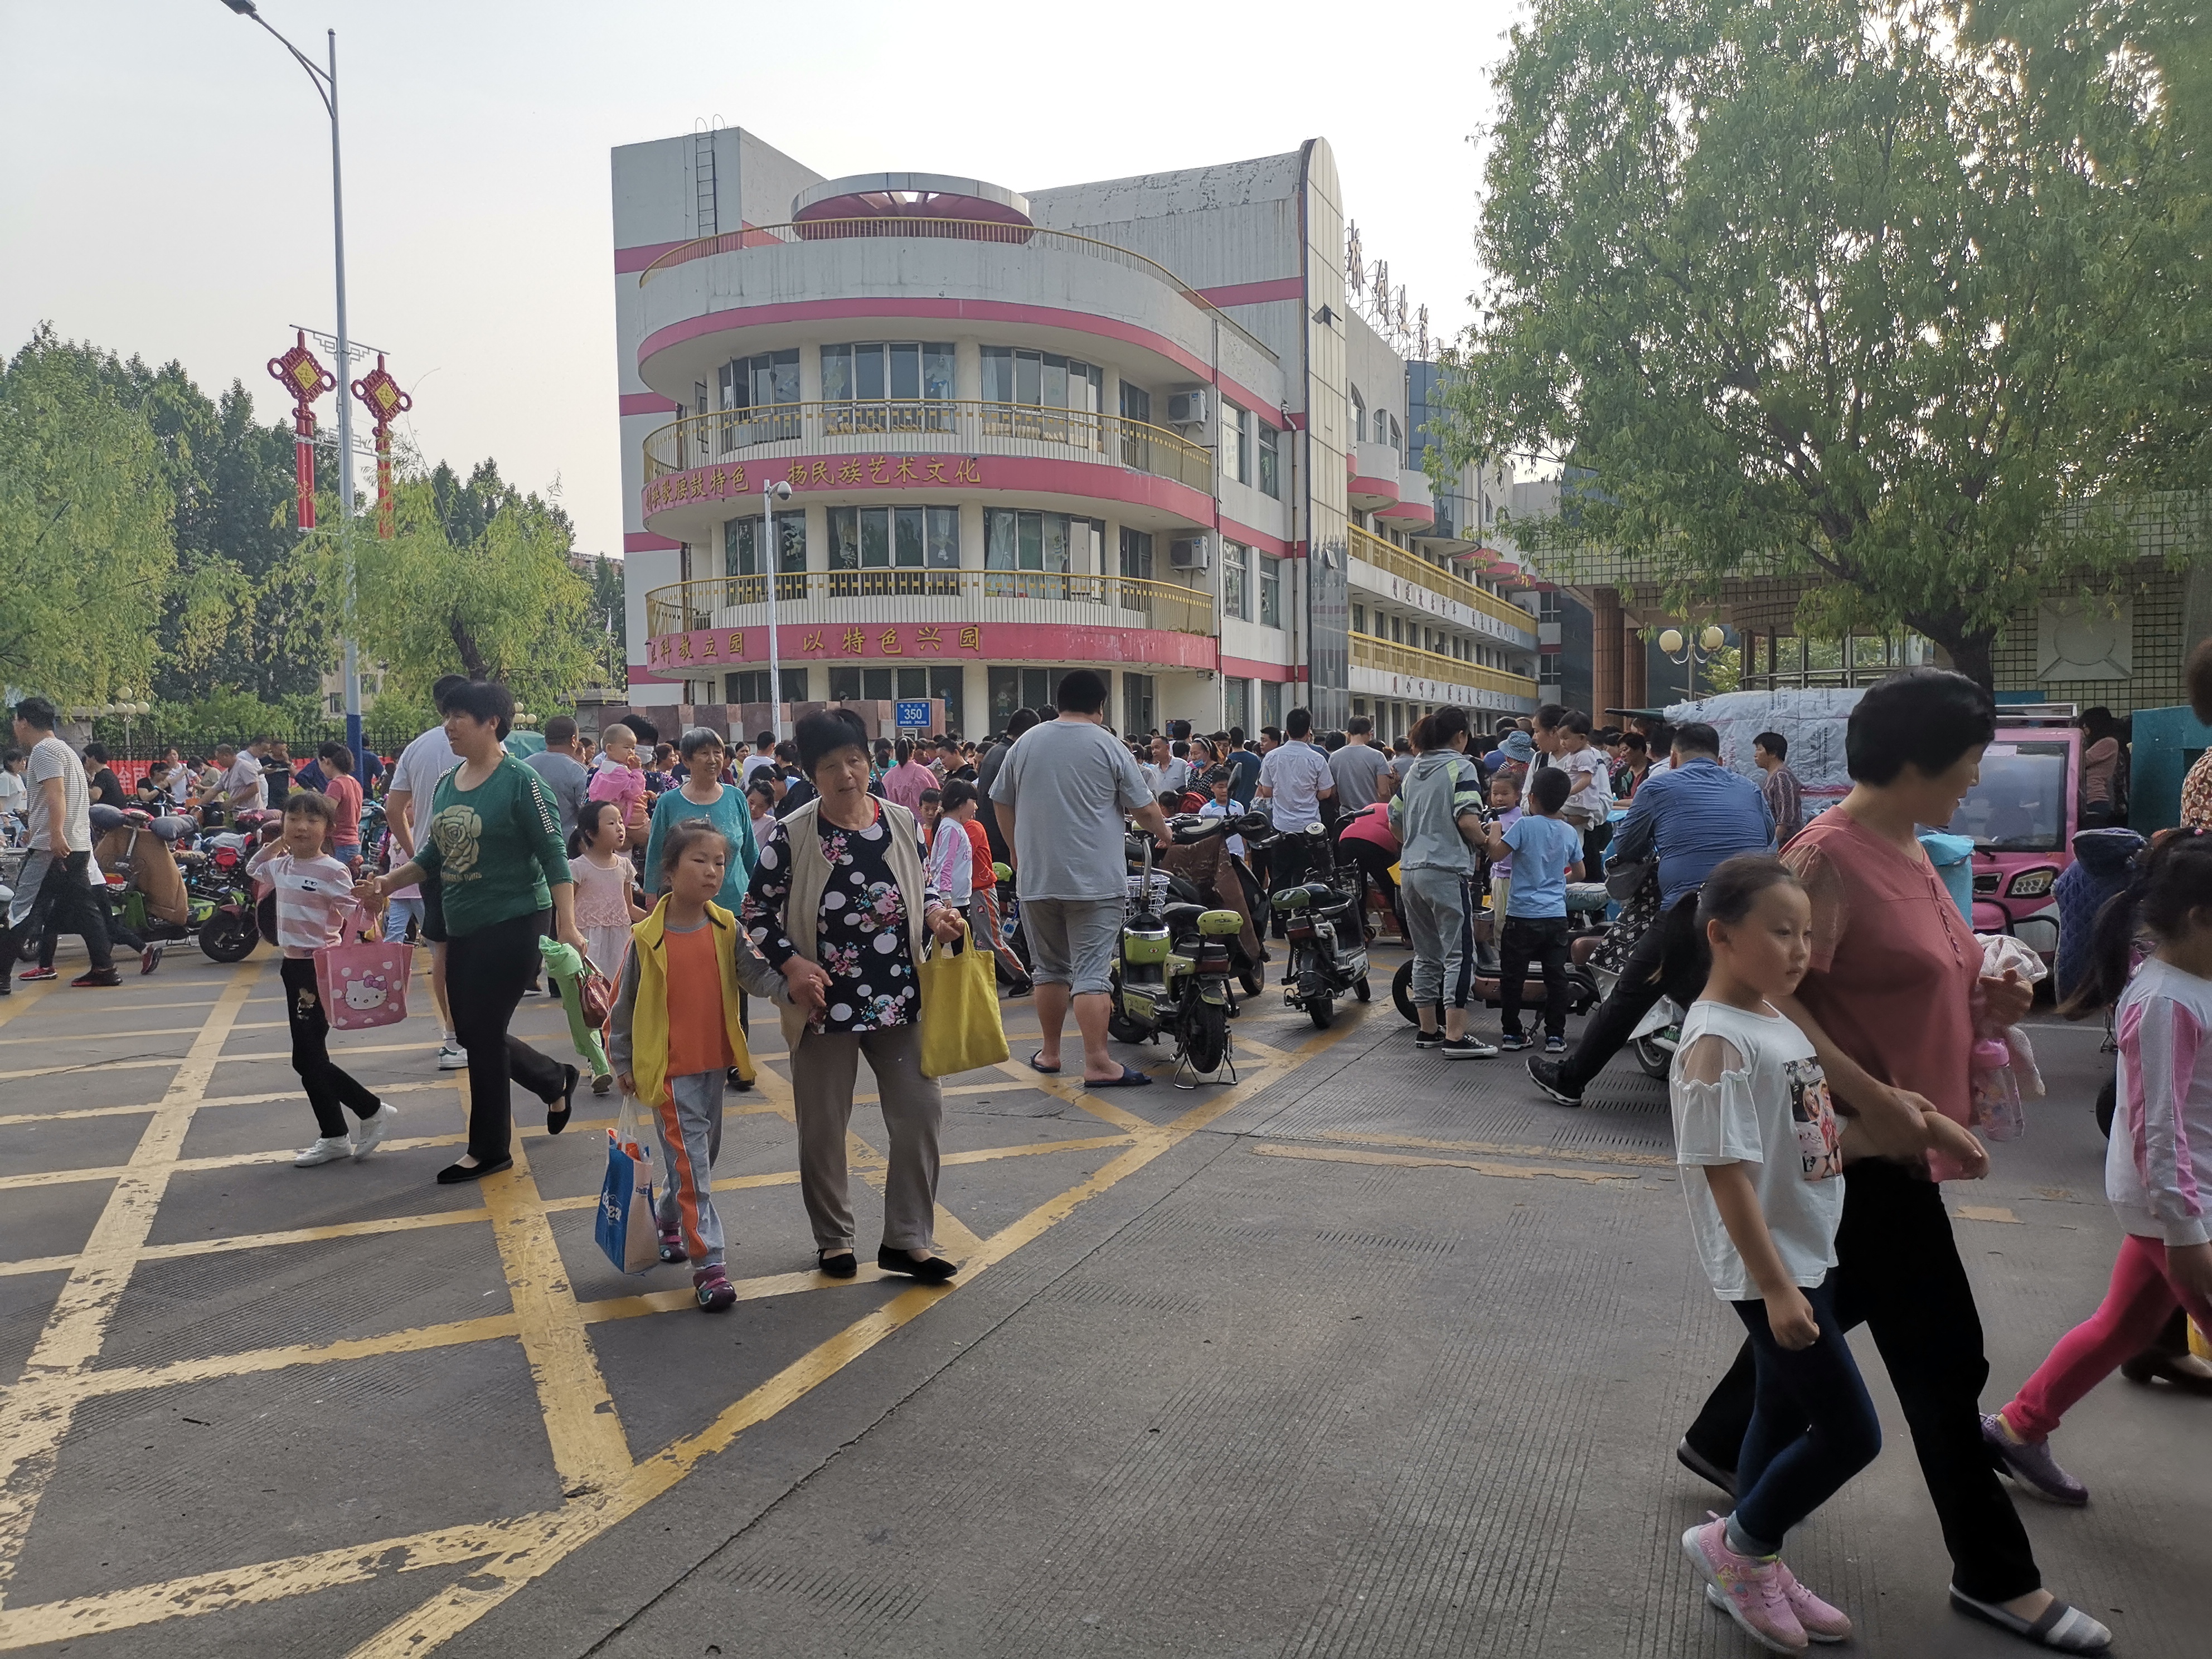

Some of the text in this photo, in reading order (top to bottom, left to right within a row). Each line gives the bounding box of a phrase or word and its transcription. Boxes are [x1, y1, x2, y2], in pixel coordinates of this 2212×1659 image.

[787, 456, 981, 484] 扬民族艺术文化
[651, 626, 980, 664] 以科教立园 以特色兴园
[904, 709, 922, 720] 350
